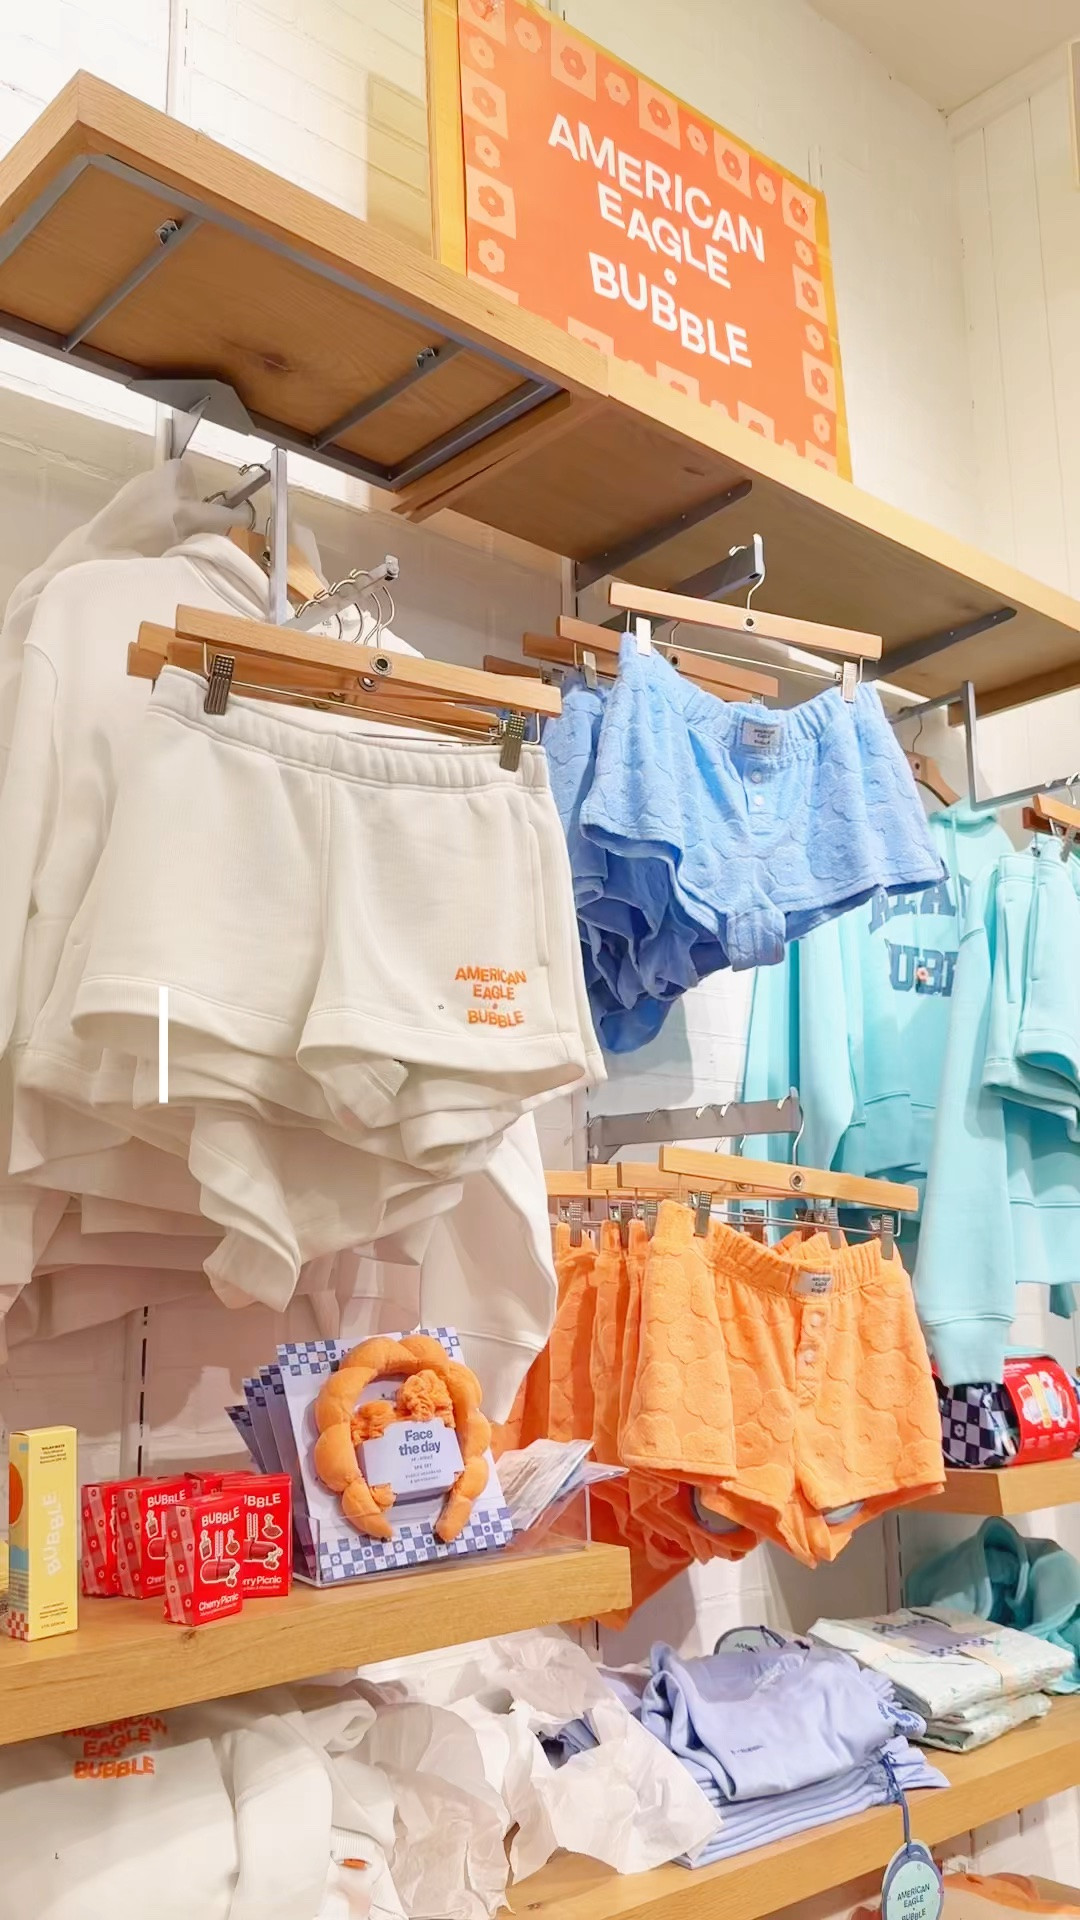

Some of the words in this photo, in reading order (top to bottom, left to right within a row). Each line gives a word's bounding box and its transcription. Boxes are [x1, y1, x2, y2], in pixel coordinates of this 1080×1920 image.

[548, 113, 766, 263] AMERICAN
[597, 181, 732, 289] EAGLE
[588, 251, 753, 368] BUBBLE
[455, 966, 527, 985] AMERICAN
[473, 984, 515, 1001] EAGLE
[467, 1009, 525, 1028] BUBBLE
[405, 1429, 433, 1442] Face
[398, 1443, 420, 1456] the
[421, 1440, 441, 1454] day
[147, 1489, 187, 1508] BUBBLE
[201, 1506, 240, 1527] BUBBLE
[42, 1490, 65, 1578] BUBBLE
[257, 1576, 283, 1585] Picnic
[199, 1599, 221, 1612] Cherry
[221, 1593, 240, 1605] Picnic
[74, 1755, 155, 1780] BUBBLE
[897, 1884, 930, 1900] AMERICAN
[904, 1895, 924, 1907] EAGLE
